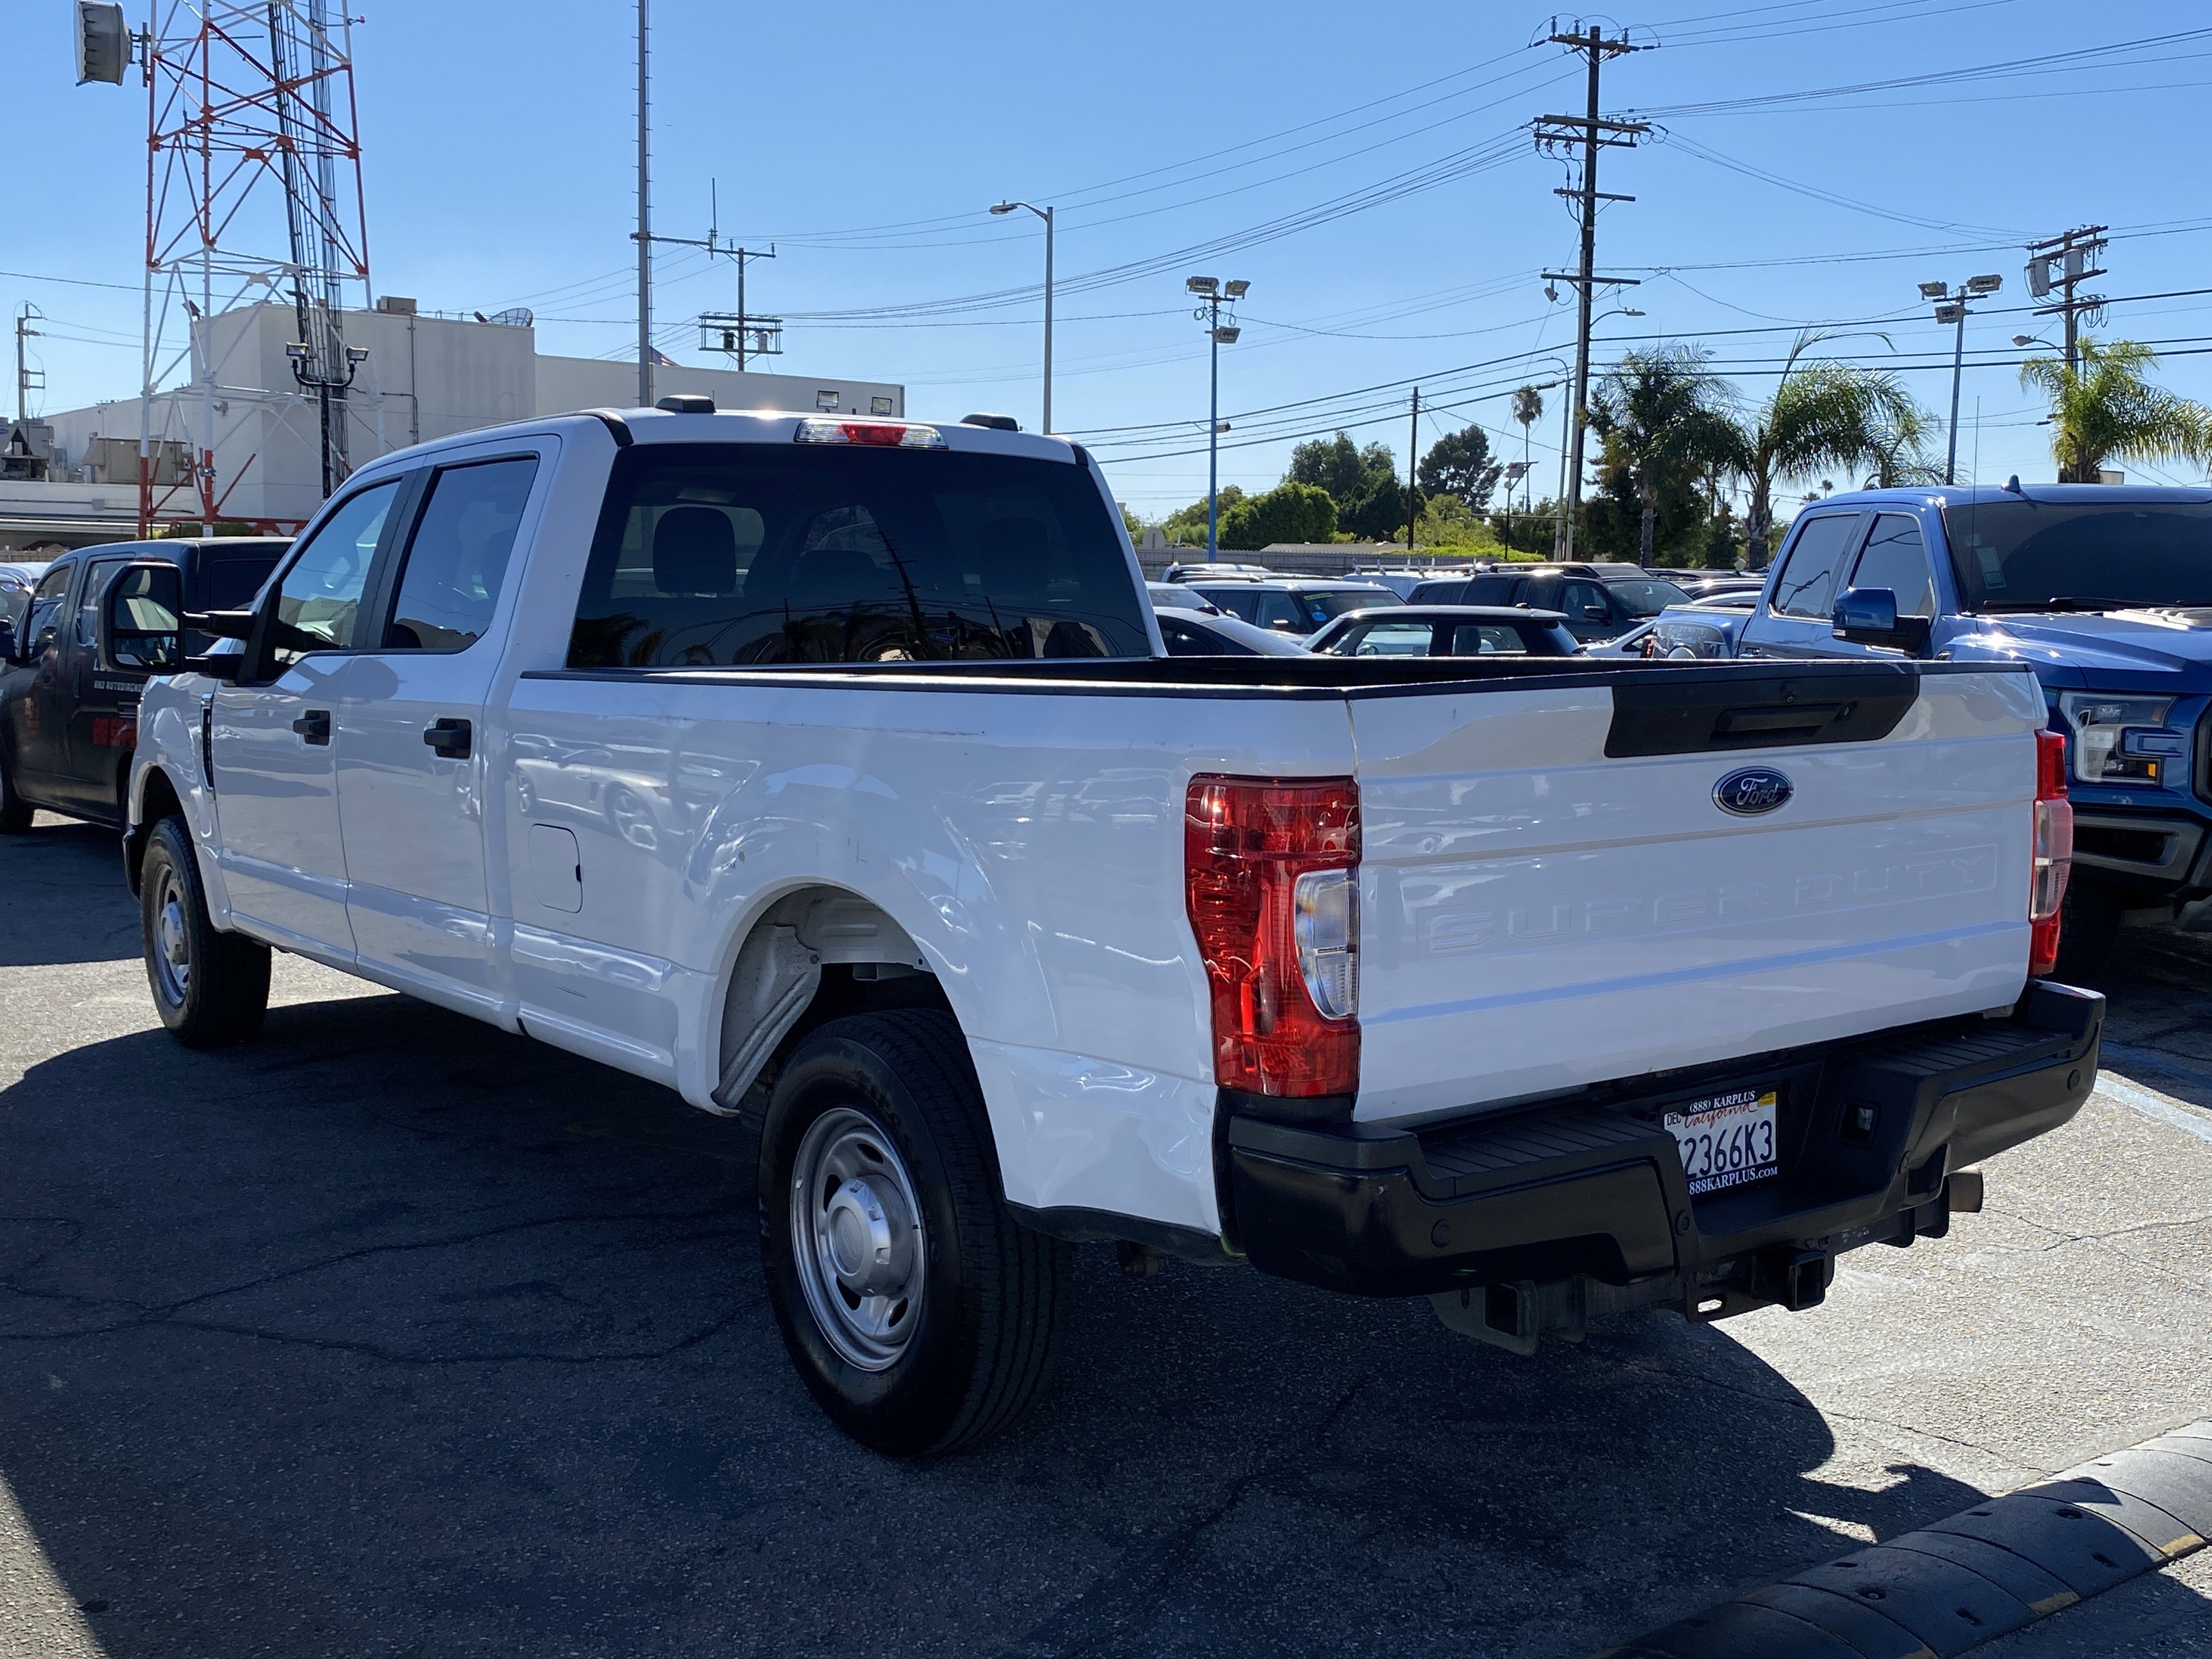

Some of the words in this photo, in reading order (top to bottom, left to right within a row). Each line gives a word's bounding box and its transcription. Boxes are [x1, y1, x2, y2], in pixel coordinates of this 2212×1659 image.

[1736, 777, 1779, 805] Ford
[1427, 883, 1770, 951] SUPER
[1795, 854, 1989, 907] DUTY
[1690, 1100, 1711, 1113] (888)
[1714, 1091, 1756, 1108] KARPLUS
[1677, 1120, 1772, 1179] 2366K3
